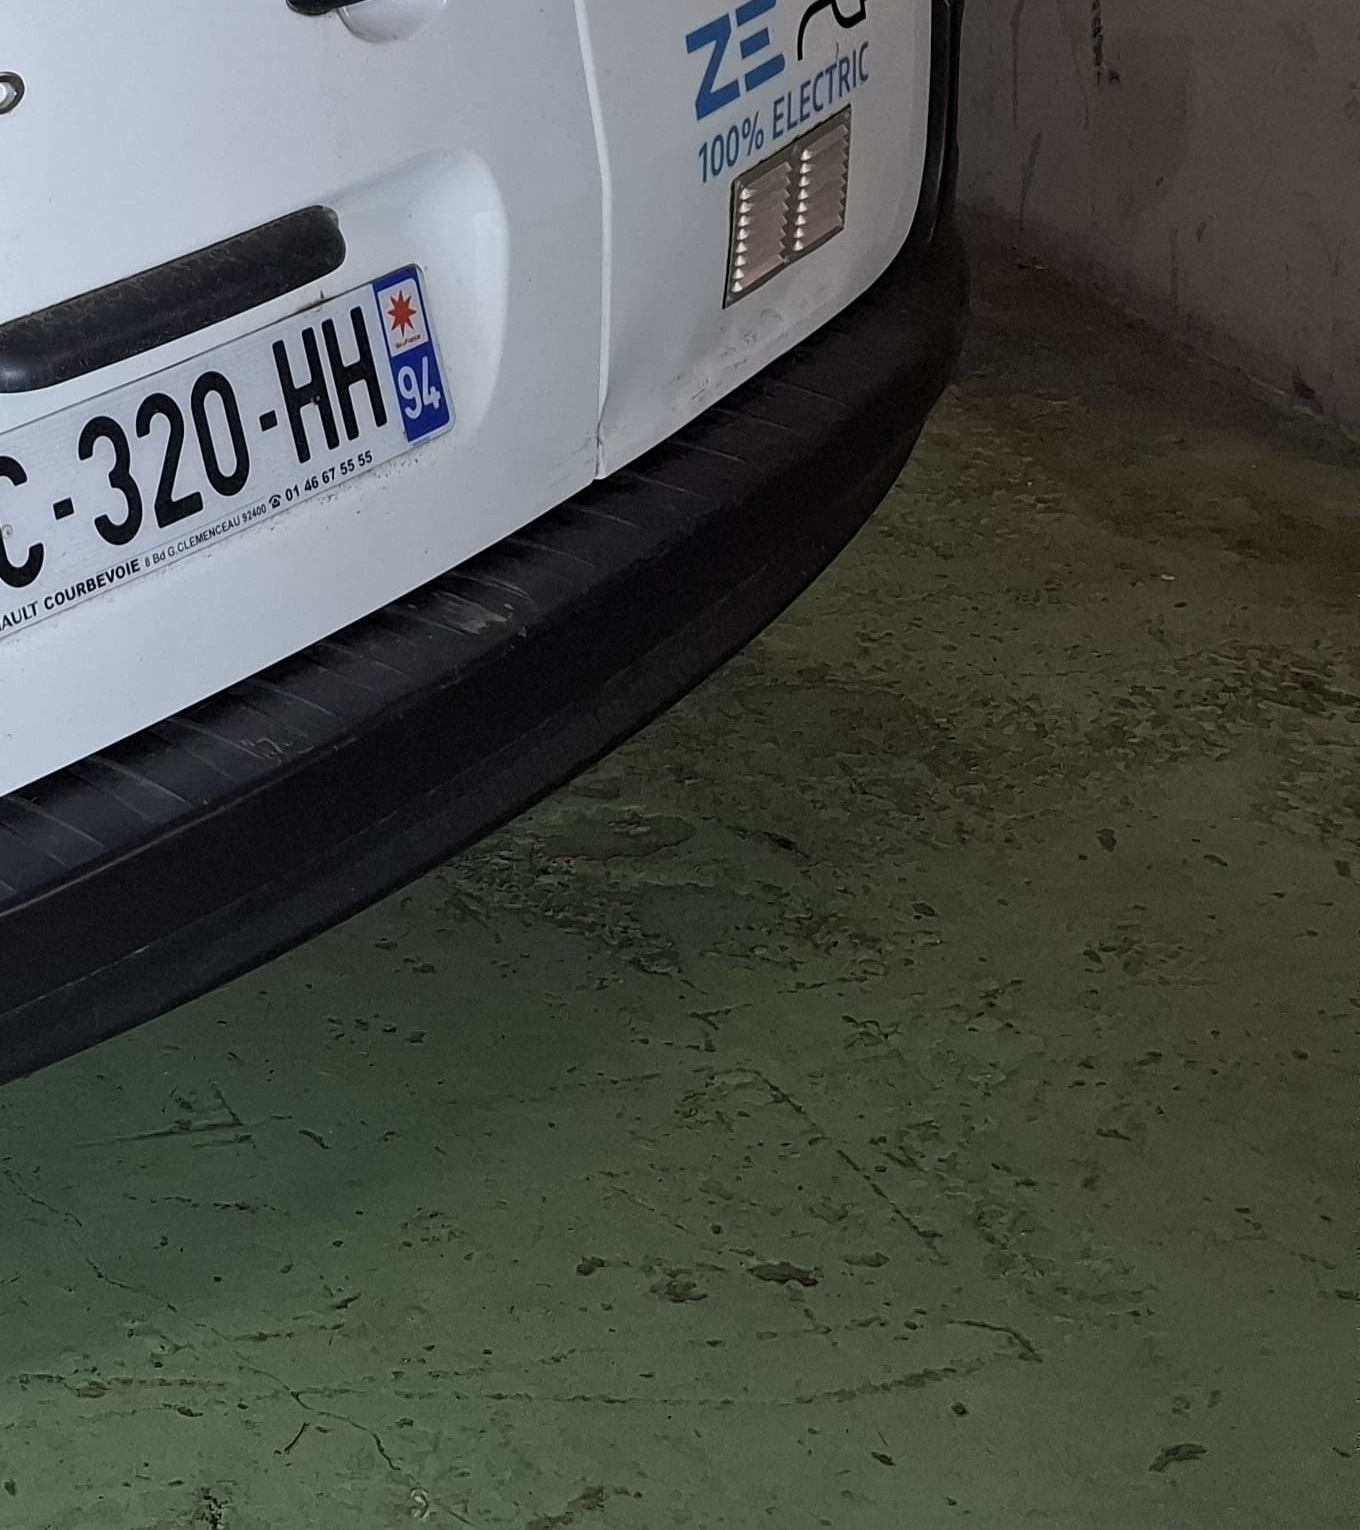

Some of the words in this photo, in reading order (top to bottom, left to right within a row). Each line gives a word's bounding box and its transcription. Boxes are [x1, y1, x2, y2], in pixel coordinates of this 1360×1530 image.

[698, 110, 765, 183] 100%
[772, 40, 870, 141] ELECTRIC
[397, 355, 442, 420] 94
[43, 558, 141, 611] COURBEVOIE
[152, 550, 166, 565] Bd
[241, 503, 268, 523] 92400
[284, 483, 300, 502] 01
[303, 475, 319, 492] 46
[321, 466, 336, 484] 67
[339, 458, 356, 476] 55
[357, 449, 374, 467] 55
